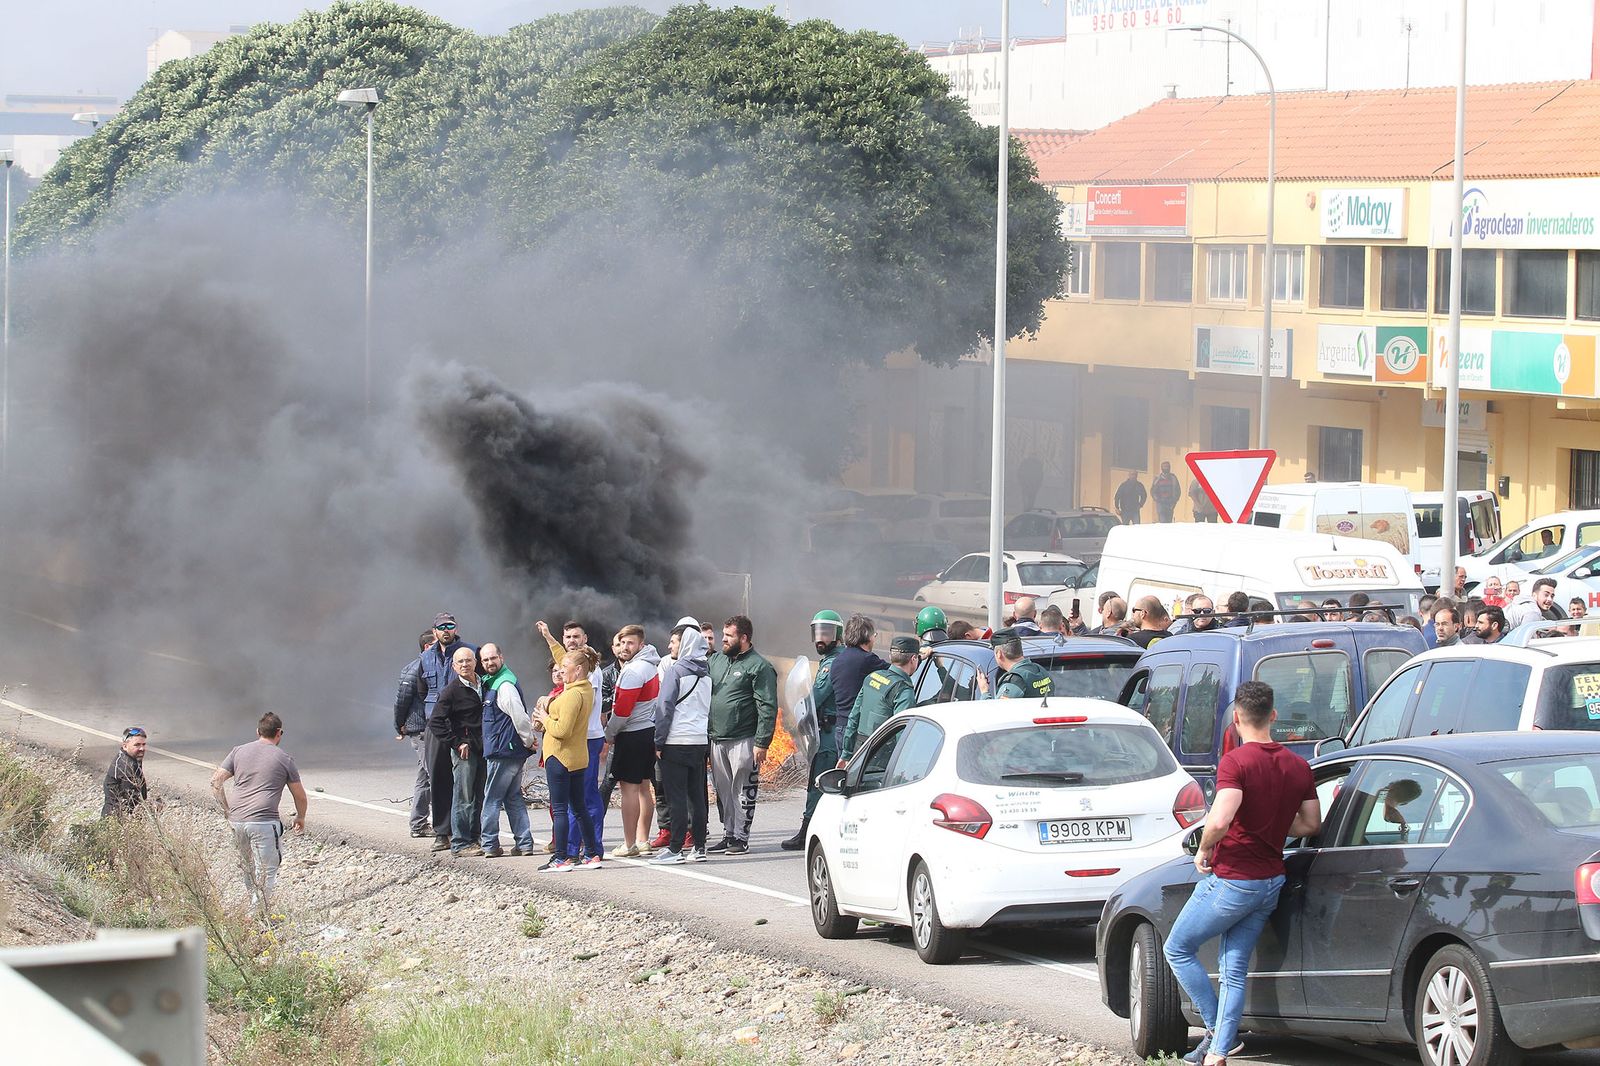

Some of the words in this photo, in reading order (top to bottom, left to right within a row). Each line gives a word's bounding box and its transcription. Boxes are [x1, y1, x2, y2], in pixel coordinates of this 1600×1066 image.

[1070, 1, 1098, 16] VENTA
[1101, 0, 1108, 14] Y
[1093, 14, 1114, 31] 950
[1123, 11, 1136, 28] 60
[1145, 9, 1159, 26] 94
[1167, 7, 1181, 24] 60
[1347, 195, 1392, 234] Motroy
[1474, 213, 1523, 240] agroclean
[1526, 212, 1594, 235] invernaderos
[1050, 822, 1091, 838] 9908
[1095, 820, 1127, 836] KPM
